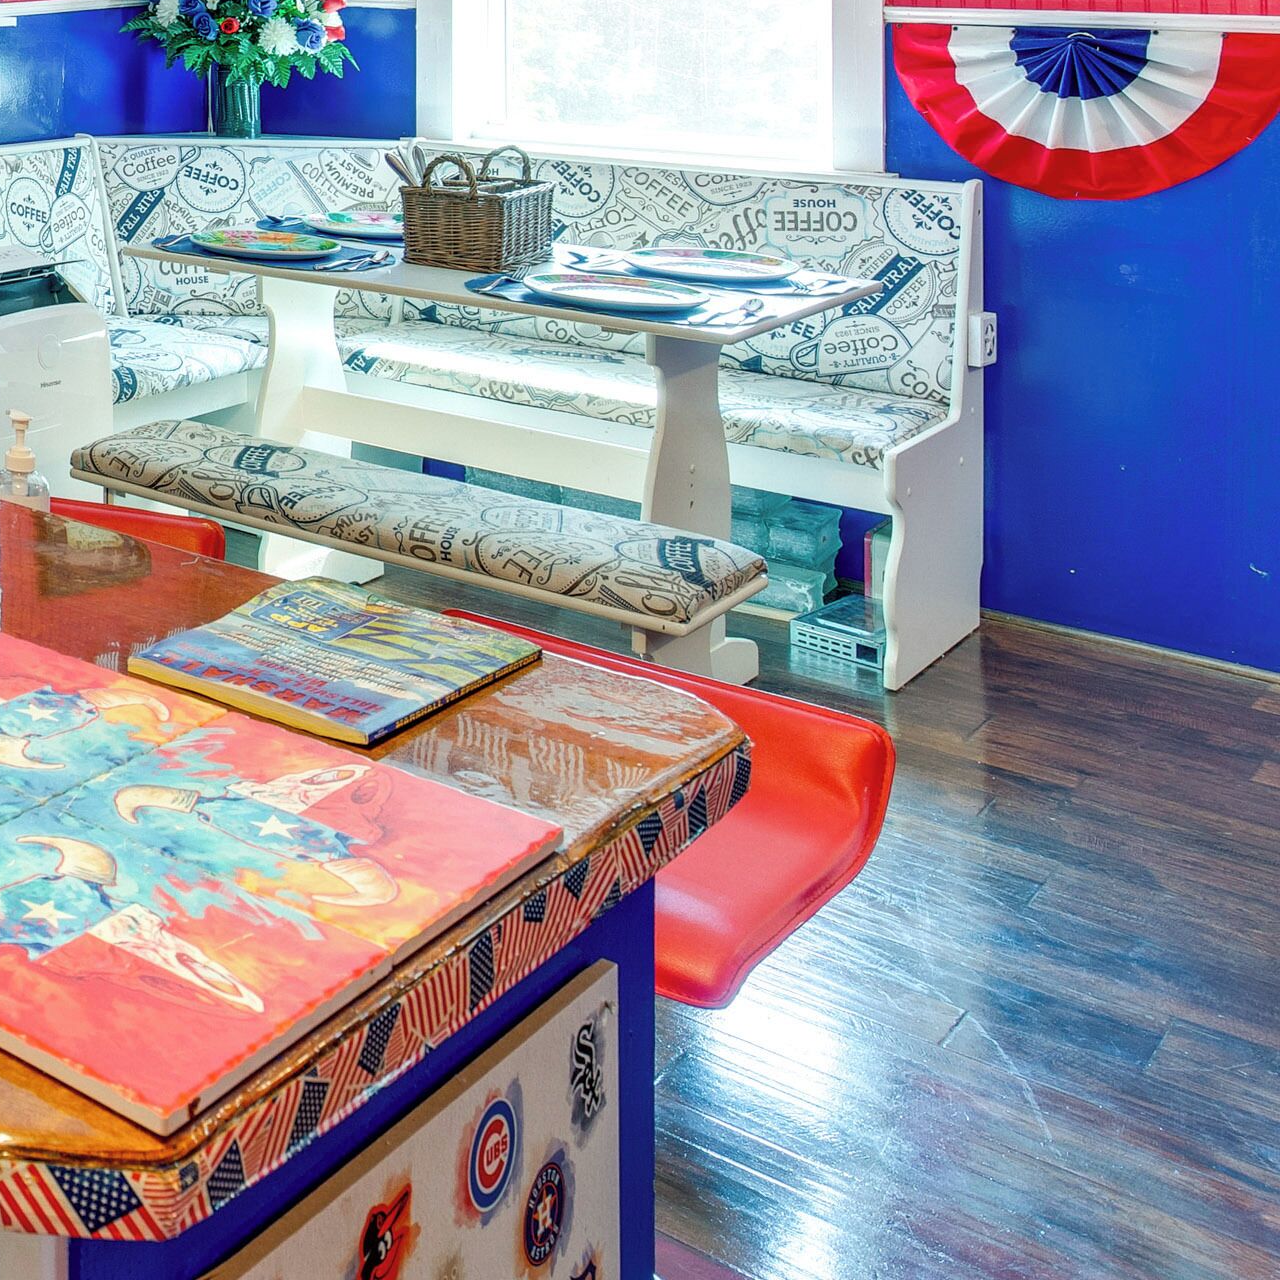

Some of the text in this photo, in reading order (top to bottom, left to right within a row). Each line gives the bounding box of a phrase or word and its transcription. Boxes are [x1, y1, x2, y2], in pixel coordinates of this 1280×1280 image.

[122, 154, 177, 177] Coffee
[130, 147, 160, 161] QUALITY
[183, 165, 239, 191] COFFEE
[325, 160, 374, 199] PREMIUM
[339, 159, 373, 185] ROAST
[551, 160, 601, 203] COFFEE
[139, 189, 160, 216] FAIR
[624, 166, 694, 218] COFFEE
[711, 185, 734, 195] SINCE
[10, 202, 48, 225] COFFEE
[793, 199, 836, 208] HOUSE
[53, 206, 86, 233] Coffee
[774, 211, 857, 232] COFFEE
[176, 275, 209, 286] HOUSE
[886, 276, 927, 316] COFFEE
[835, 325, 881, 338] SINCE 1923
[824, 334, 899, 357] Coffee
[844, 354, 888, 368] QUALITY
[241, 447, 270, 470] COFFEE
[665, 540, 696, 572] COFFEE
[270, 612, 329, 634] APP
[159, 650, 370, 724] MARSHALL
[395, 654, 540, 729] MARSHALL TELEPHONE DIRECTORY
[529, 1166, 562, 1209] HOUSTON
[536, 1195, 554, 1235] H
